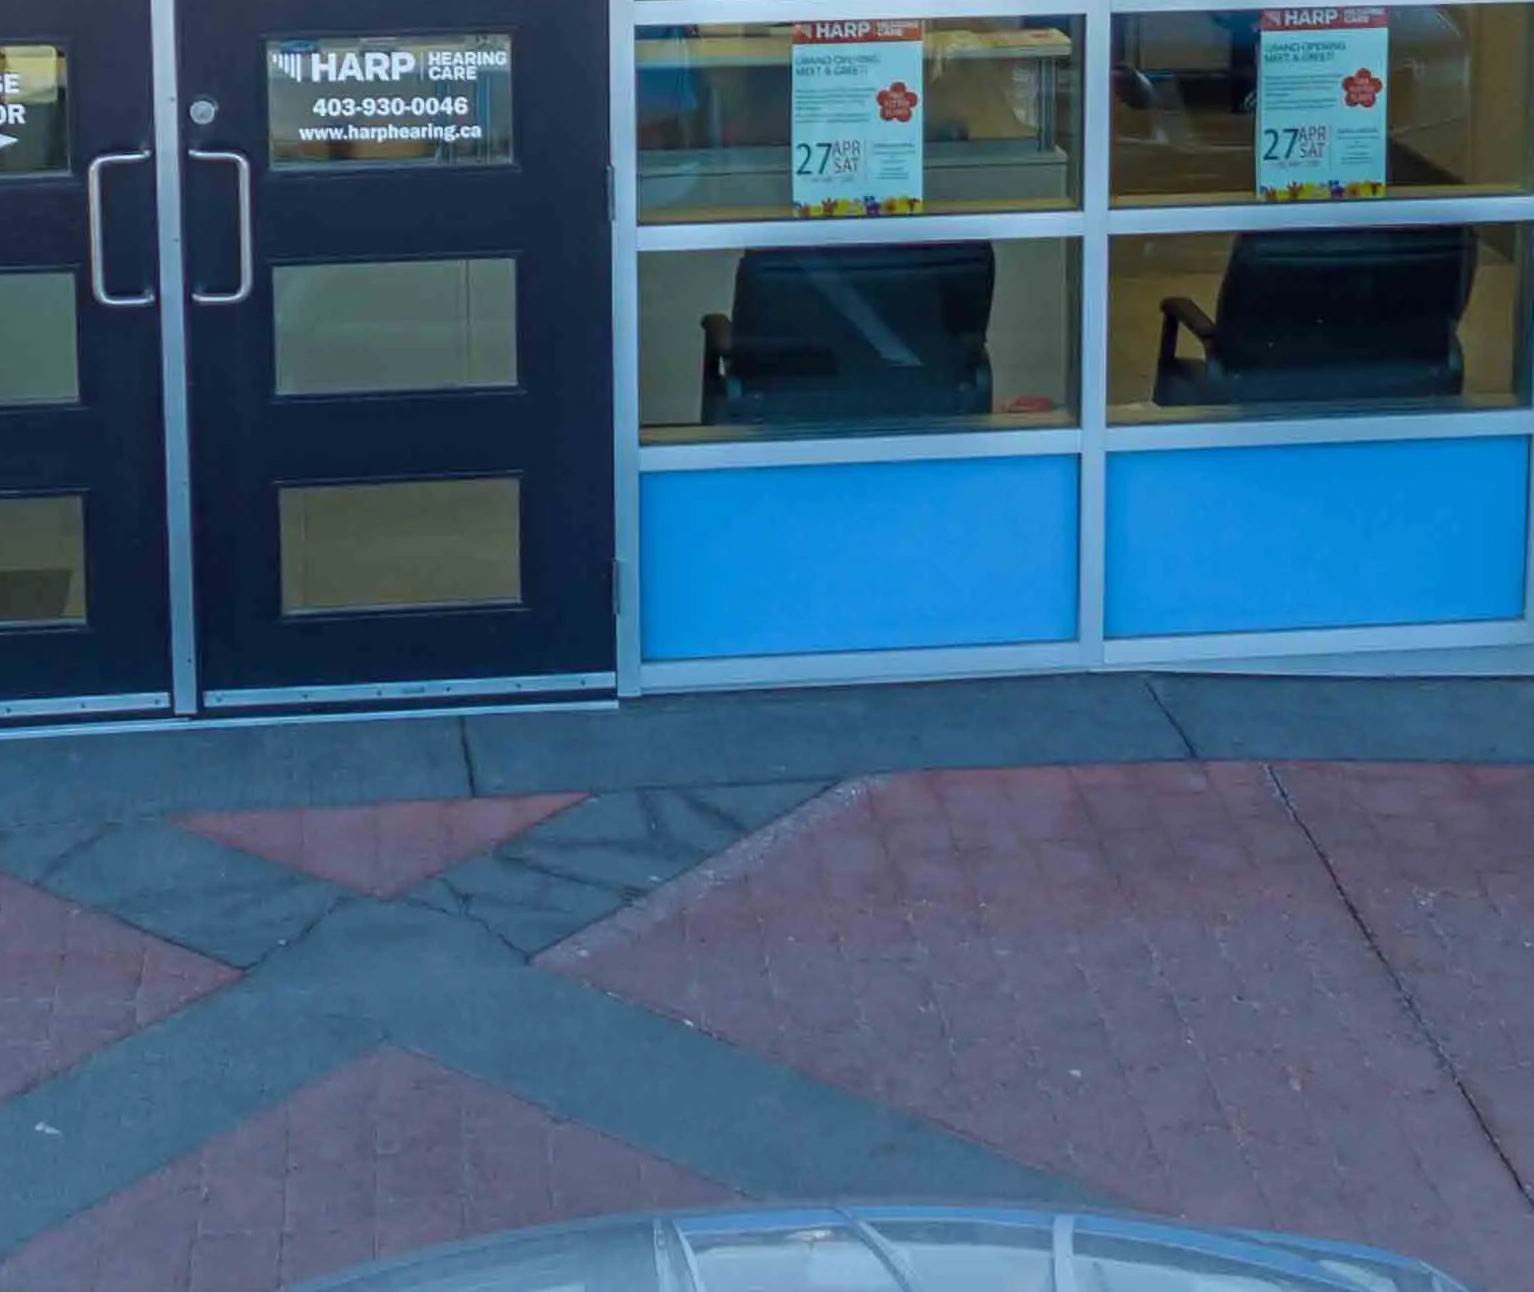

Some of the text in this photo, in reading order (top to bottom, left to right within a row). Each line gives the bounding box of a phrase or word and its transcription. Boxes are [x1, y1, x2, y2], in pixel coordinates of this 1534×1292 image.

[1284, 9, 1338, 26] HARP
[816, 21, 870, 38] HARP
[311, 52, 415, 82] HARP
[428, 51, 507, 66] HEARING
[428, 66, 477, 81] CARE
[312, 97, 468, 117] 403-930-0046
[299, 123, 482, 142] www.harphearing.ca
[1263, 126, 1326, 161] 27 APR
[1300, 142, 1325, 157] SAT
[795, 140, 860, 175] 27 APR
[834, 157, 859, 173] SAT
